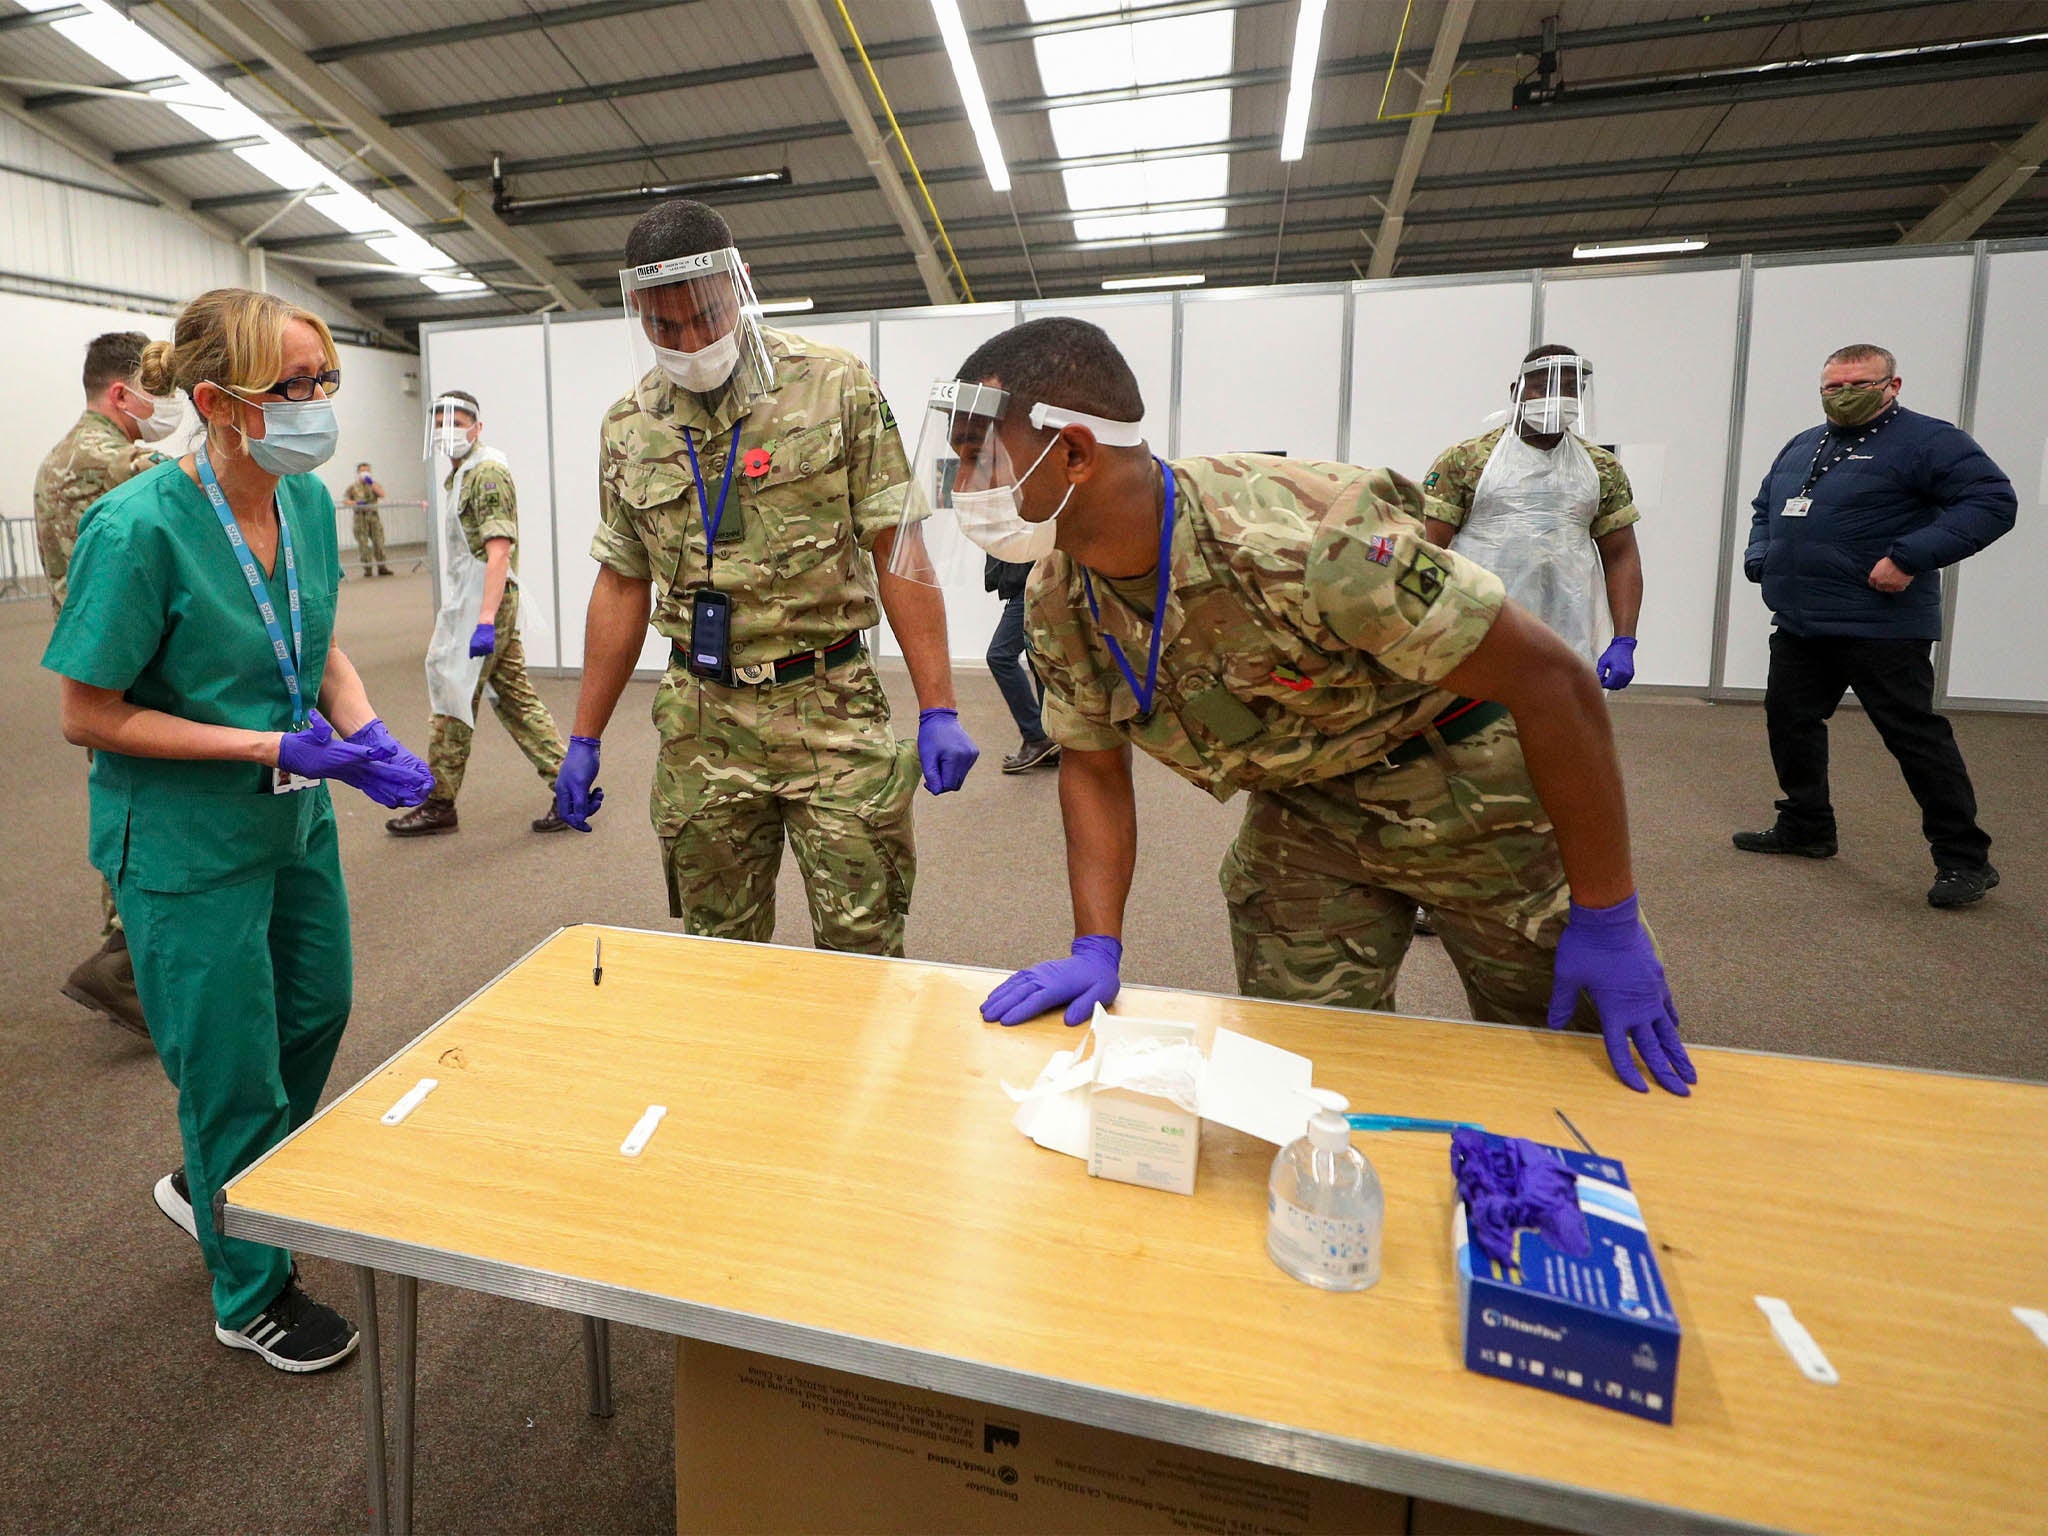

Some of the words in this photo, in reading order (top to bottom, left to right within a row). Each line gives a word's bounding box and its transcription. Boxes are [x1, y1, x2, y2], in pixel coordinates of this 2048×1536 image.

[637, 264, 659, 277] MIERS
[207, 483, 224, 505] NHS
[225, 525, 242, 546] NHS
[244, 564, 260, 585] NHS
[290, 590, 299, 611] NHS
[261, 604, 275, 624] NHS
[275, 640, 288, 659] NHS
[286, 675, 298, 694] NHS
[927, 1451, 995, 1477] Tried&Tested
[966, 1481, 1017, 1501] Distributor
